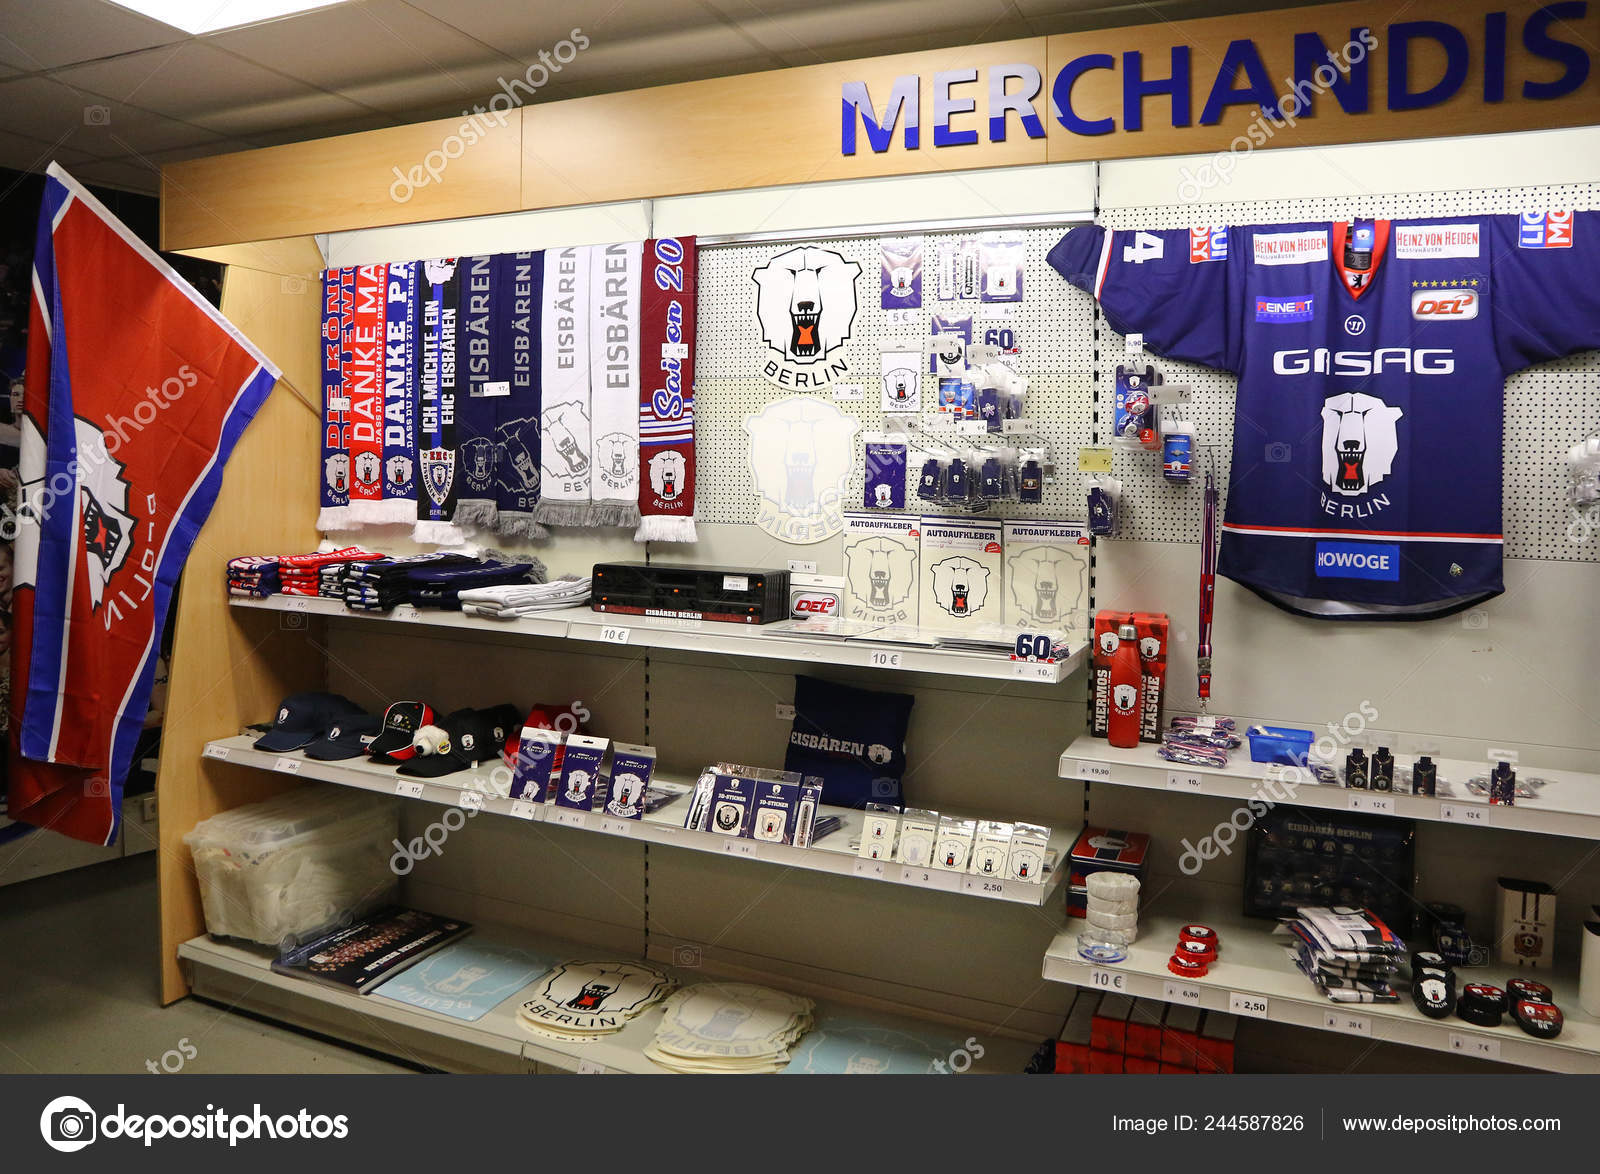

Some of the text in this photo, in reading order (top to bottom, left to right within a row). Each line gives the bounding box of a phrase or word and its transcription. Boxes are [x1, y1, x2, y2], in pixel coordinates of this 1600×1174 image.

[842, 1, 1591, 155] MERCHANDIS
[1254, 236, 1328, 254] HEINZ VON HEIDEN
[1397, 230, 1478, 247] HEINZ VON HEIDEN
[655, 238, 684, 292] 20
[407, 299, 415, 322] DEN
[554, 248, 576, 368] EISBÄREN
[1256, 299, 1313, 313] REINERT
[1416, 293, 1474, 315] DEL
[600, 244, 629, 388] EISBÄREN
[892, 312, 909, 322] 5 €
[377, 322, 383, 338] ZU
[407, 322, 414, 338] ZU
[465, 256, 490, 397] EISBÄREN
[511, 265, 531, 387] EISBÄREN
[985, 328, 1014, 350] 60
[384, 262, 409, 446] DANKE PA
[406, 342, 414, 365] MIT
[653, 300, 684, 418] Saion
[421, 300, 439, 433] ICH MÖCHTE EIN
[440, 308, 456, 425] EHC EISBÄREN
[762, 357, 849, 388] BERLIN
[353, 326, 377, 442] DANKE
[375, 363, 383, 394] MICH
[405, 366, 413, 399] MICH
[375, 396, 383, 413] DU
[405, 400, 413, 417] DU
[889, 399, 916, 410] BERLIN
[354, 481, 381, 496] BERLIN
[386, 483, 414, 496] BERLIN
[601, 473, 634, 489] BERLIN
[652, 498, 684, 510] BERLIN
[1319, 491, 1391, 519] BERLIN
[850, 520, 913, 530] AUTOAUFKLEBER
[1011, 527, 1082, 538] AUTOAUFKLEBER
[926, 529, 996, 541] AUTOAUFKLEBER
[1317, 551, 1390, 570] HOWOGE
[645, 608, 703, 620] EISBÄREN BERLIN
[794, 597, 835, 614] DEL
[603, 629, 625, 640] 10 €
[1016, 634, 1051, 659] 60
[873, 654, 899, 665] 10 €
[1037, 669, 1053, 677] 10,-
[1094, 669, 1108, 732] THERMOS
[1143, 676, 1160, 739] FLASCHE
[1114, 707, 1135, 716] BERLIN
[791, 730, 865, 756] EISBÄREN
[983, 883, 1002, 892] 2,50
[1093, 973, 1122, 988] 10 €
[530, 1003, 616, 1028] BERLIN
[1244, 1001, 1266, 1012] 2,50
